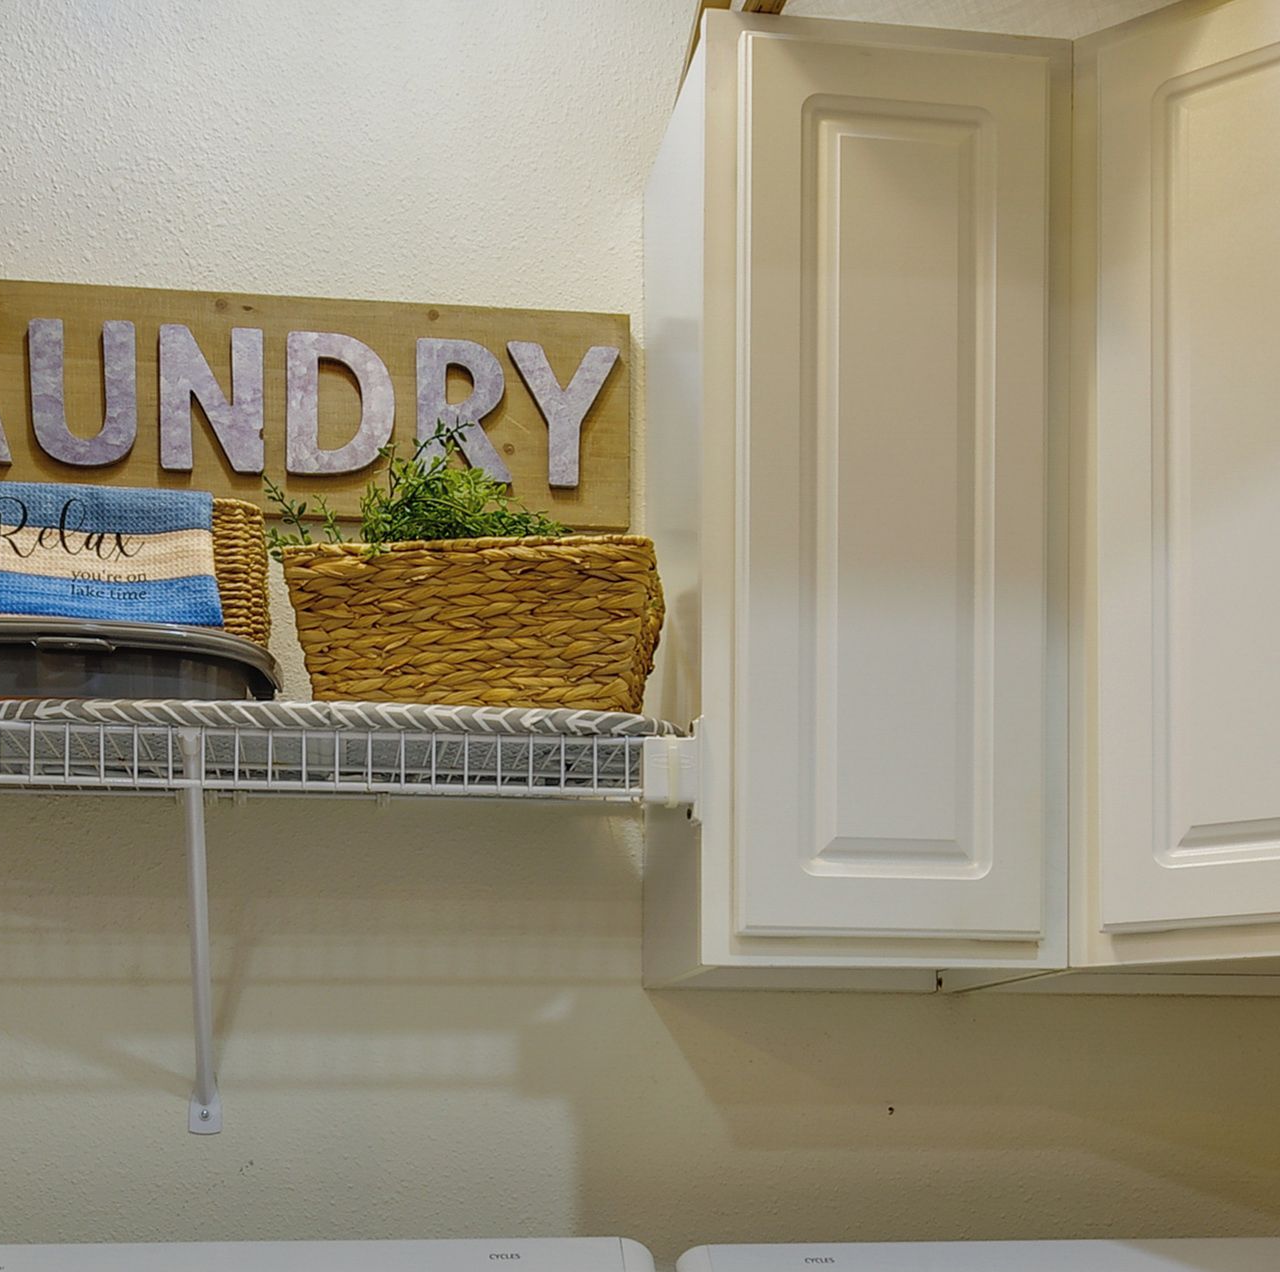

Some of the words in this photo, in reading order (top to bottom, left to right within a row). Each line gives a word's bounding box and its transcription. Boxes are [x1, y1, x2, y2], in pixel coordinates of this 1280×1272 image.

[72, 570, 122, 583] you're
[127, 572, 147, 583] on
[71, 584, 108, 599] lake
[110, 588, 147, 600] time
